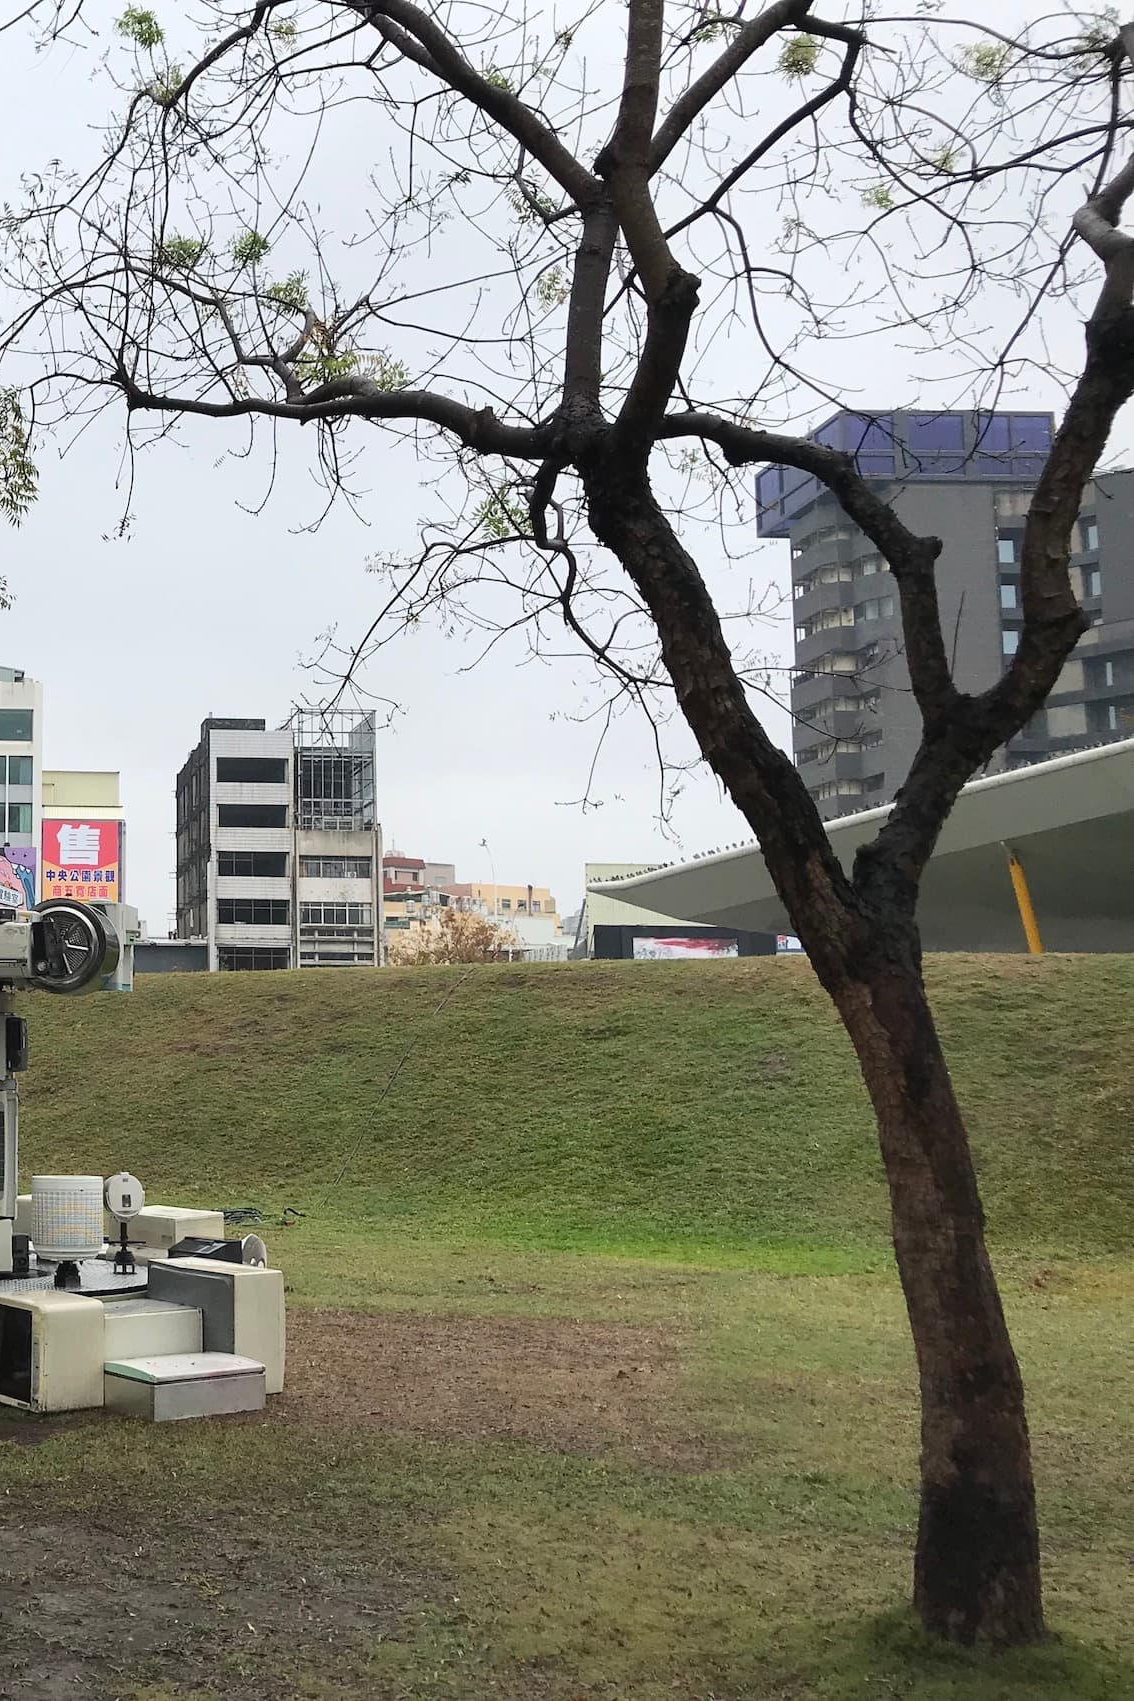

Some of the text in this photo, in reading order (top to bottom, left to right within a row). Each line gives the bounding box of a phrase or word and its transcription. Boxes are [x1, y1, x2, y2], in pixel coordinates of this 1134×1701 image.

[57, 824, 101, 865] 售
[46, 869, 115, 882] 中央公園景觀
